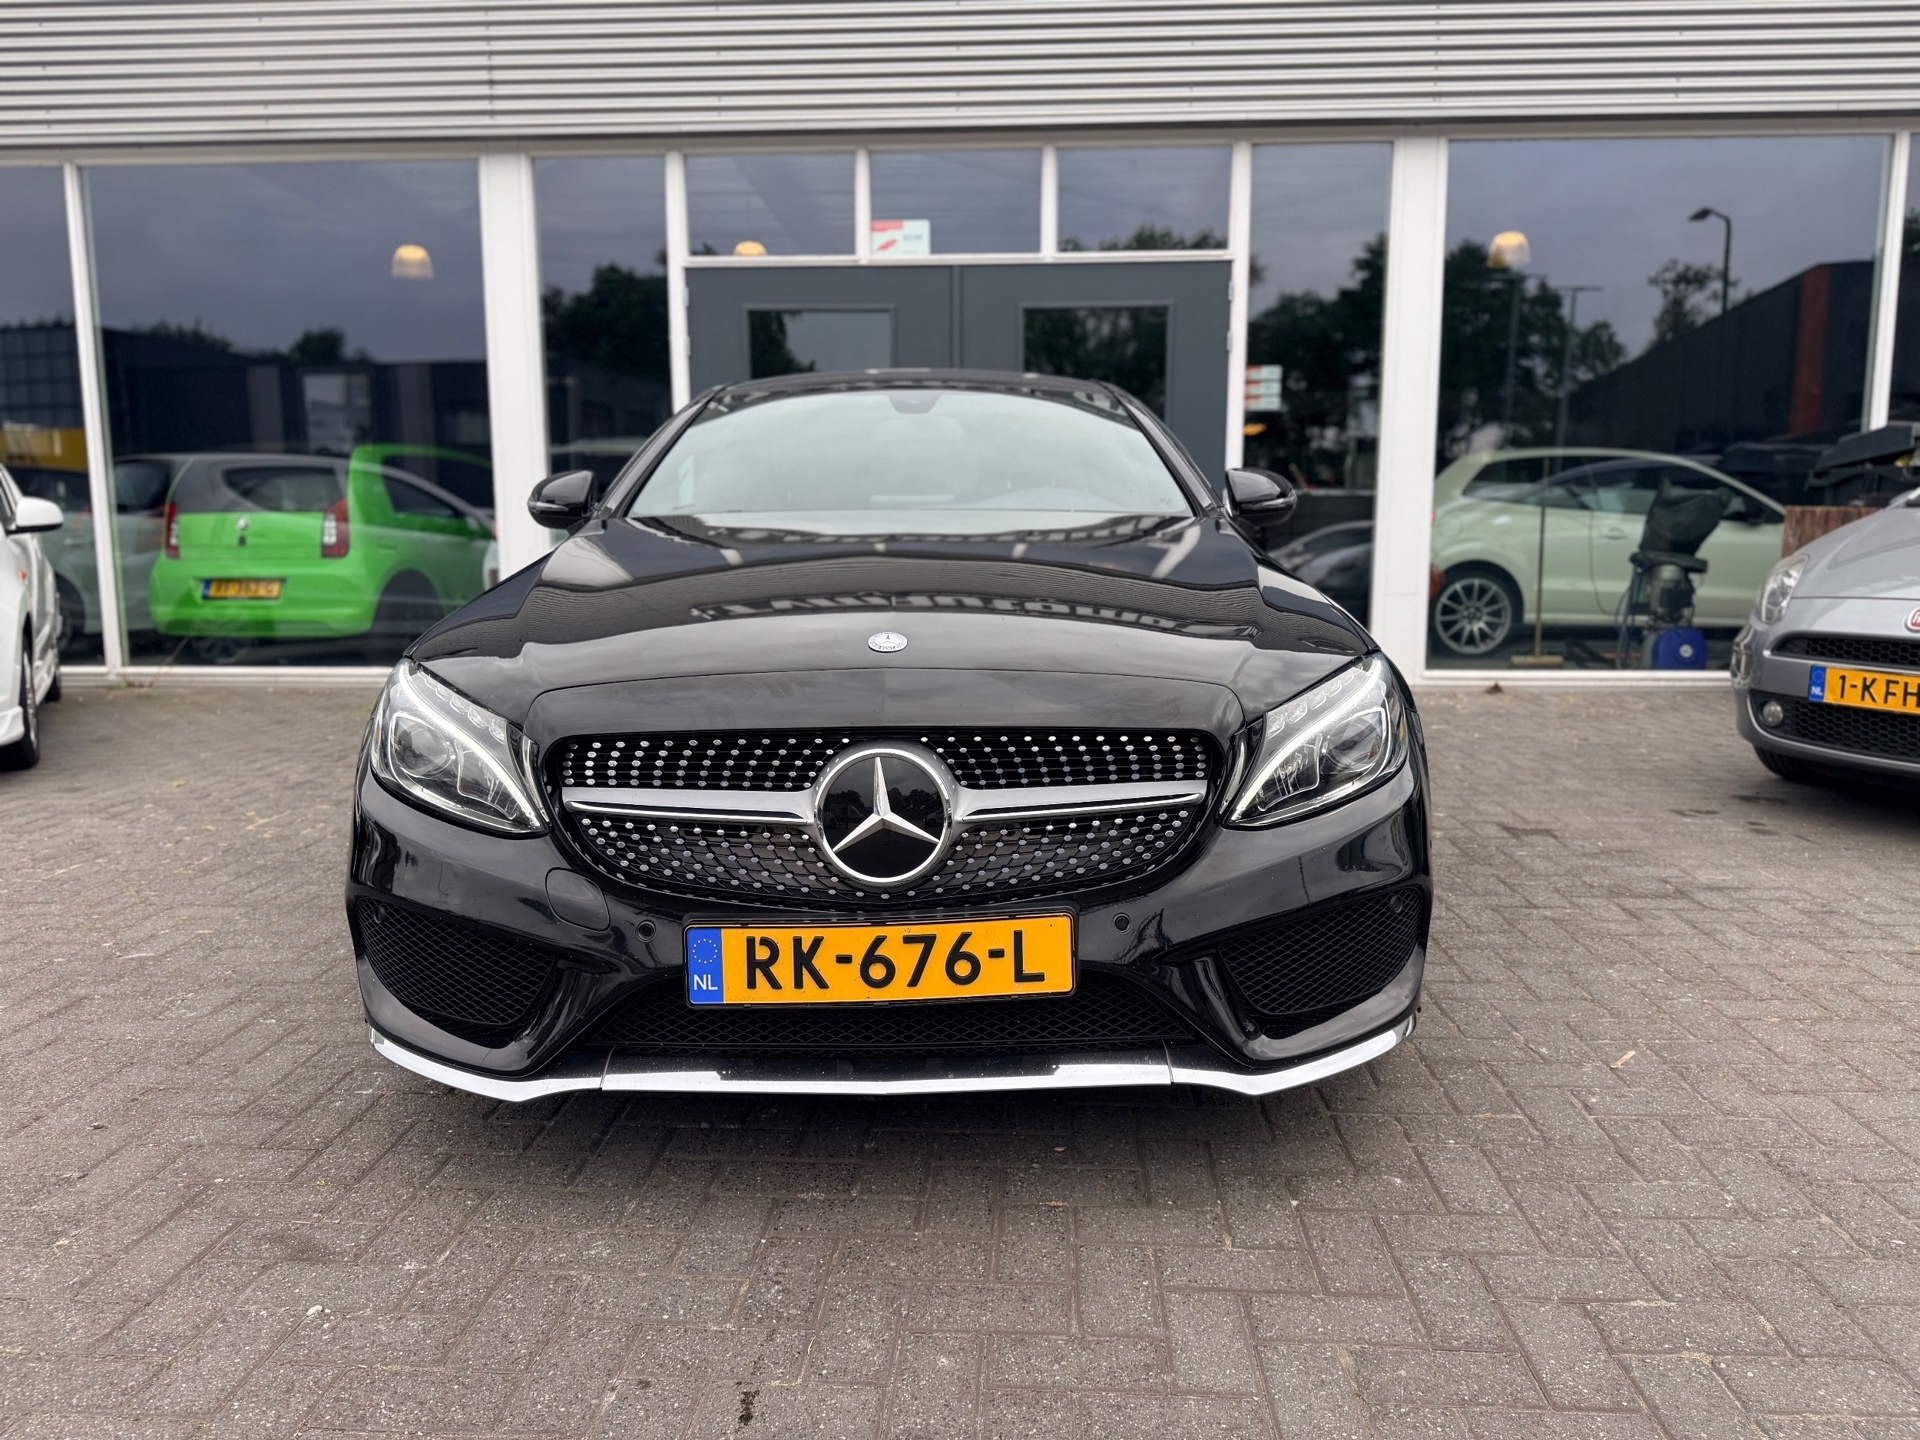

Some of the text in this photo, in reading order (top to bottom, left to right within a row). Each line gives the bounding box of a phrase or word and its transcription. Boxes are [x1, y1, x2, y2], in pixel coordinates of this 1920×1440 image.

[1811, 686, 1823, 696] NL
[745, 930, 1045, 989] RK-676-L
[693, 974, 719, 991] NL
